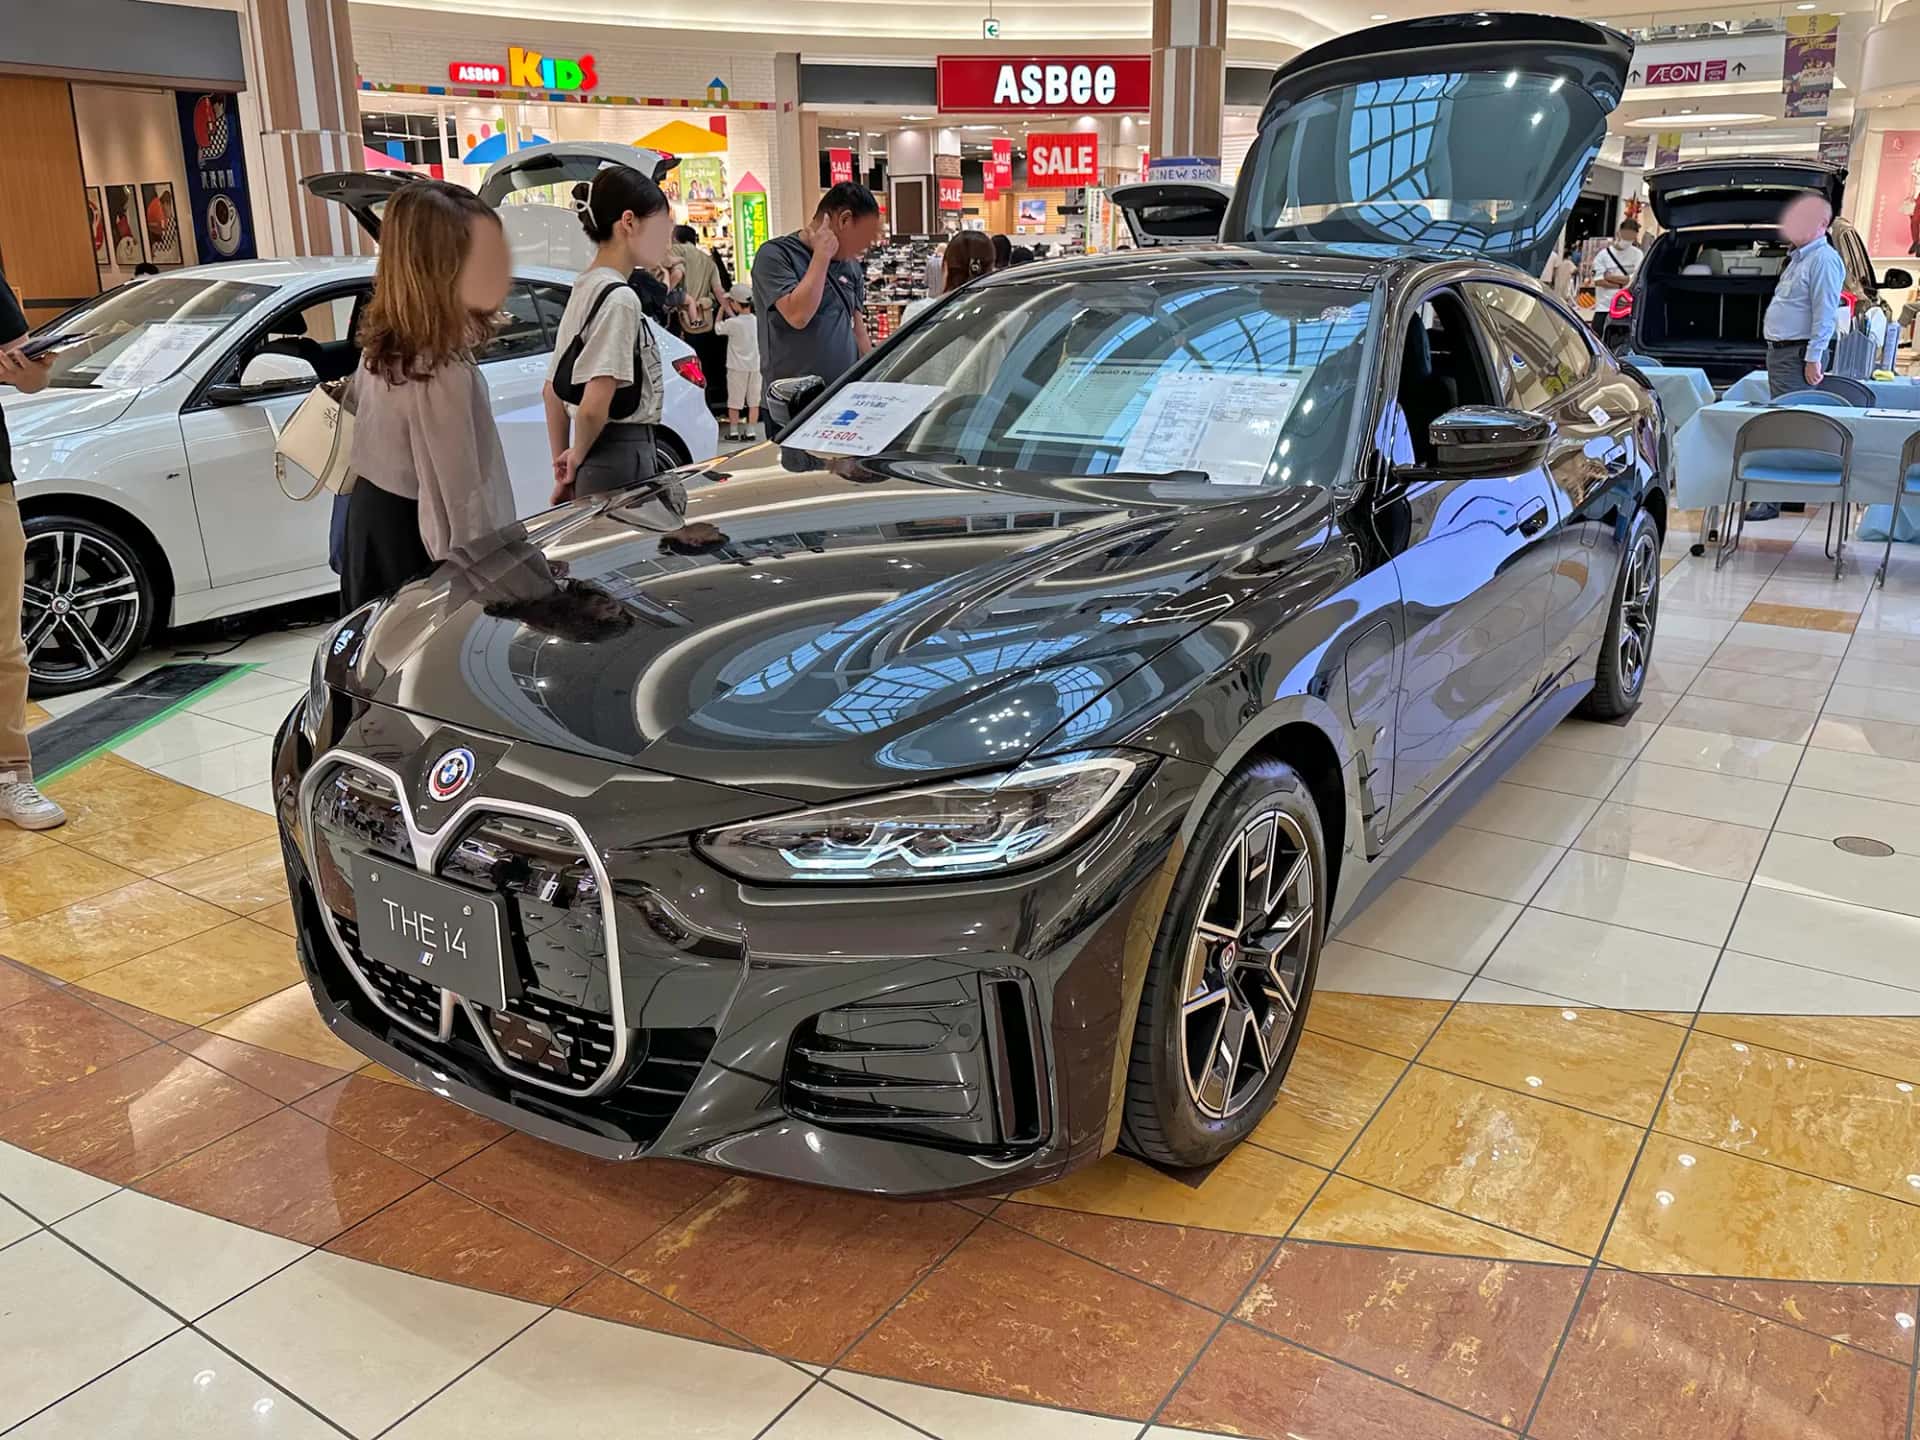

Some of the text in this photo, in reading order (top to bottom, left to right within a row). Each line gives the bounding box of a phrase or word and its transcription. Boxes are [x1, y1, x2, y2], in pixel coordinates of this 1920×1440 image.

[508, 47, 598, 91] KIDS
[993, 64, 1117, 105] ASBee
[831, 161, 851, 173] SALE
[993, 152, 1011, 165] SALE
[1032, 146, 1094, 176] SALE
[1160, 168, 1188, 180] NEW
[939, 188, 961, 202] SALE
[382, 898, 468, 959] THE i4
